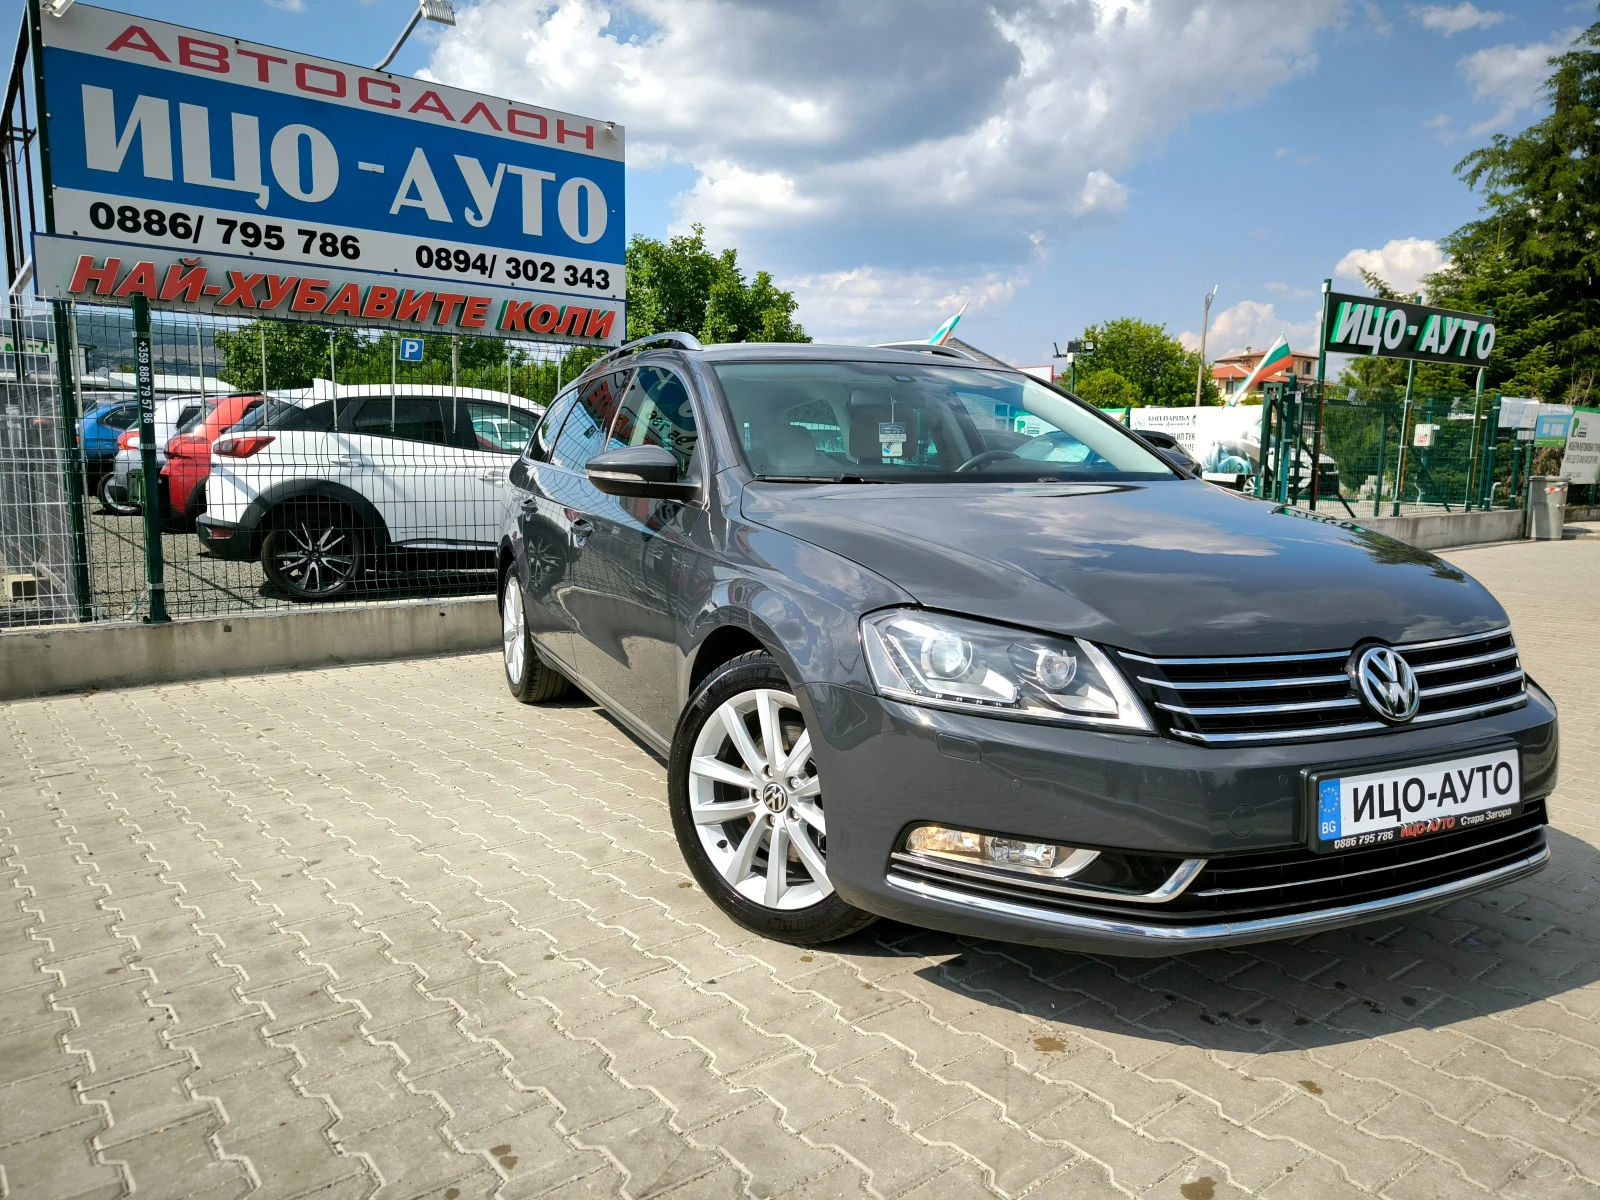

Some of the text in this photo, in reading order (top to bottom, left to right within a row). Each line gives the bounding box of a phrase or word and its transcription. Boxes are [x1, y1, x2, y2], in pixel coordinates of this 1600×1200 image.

[106, 24, 595, 150] АВТОСАЛОН
[89, 201, 361, 260] 0886/ 795 786
[68, 254, 616, 338] НАЙ-ХУБАВИТЕ КОЛИ
[415, 245, 610, 290] 0894/ 302 343
[405, 341, 419, 358] P
[1333, 301, 1496, 360] ИЦО-АУТО
[138, 341, 154, 424] +359 886 79 57 86
[1353, 761, 1513, 823] ИЦО-АУТО
[1321, 820, 1337, 835] BG
[1334, 807, 1513, 850] 0886 795 786 ИЦО-АУТО Стара Загора
